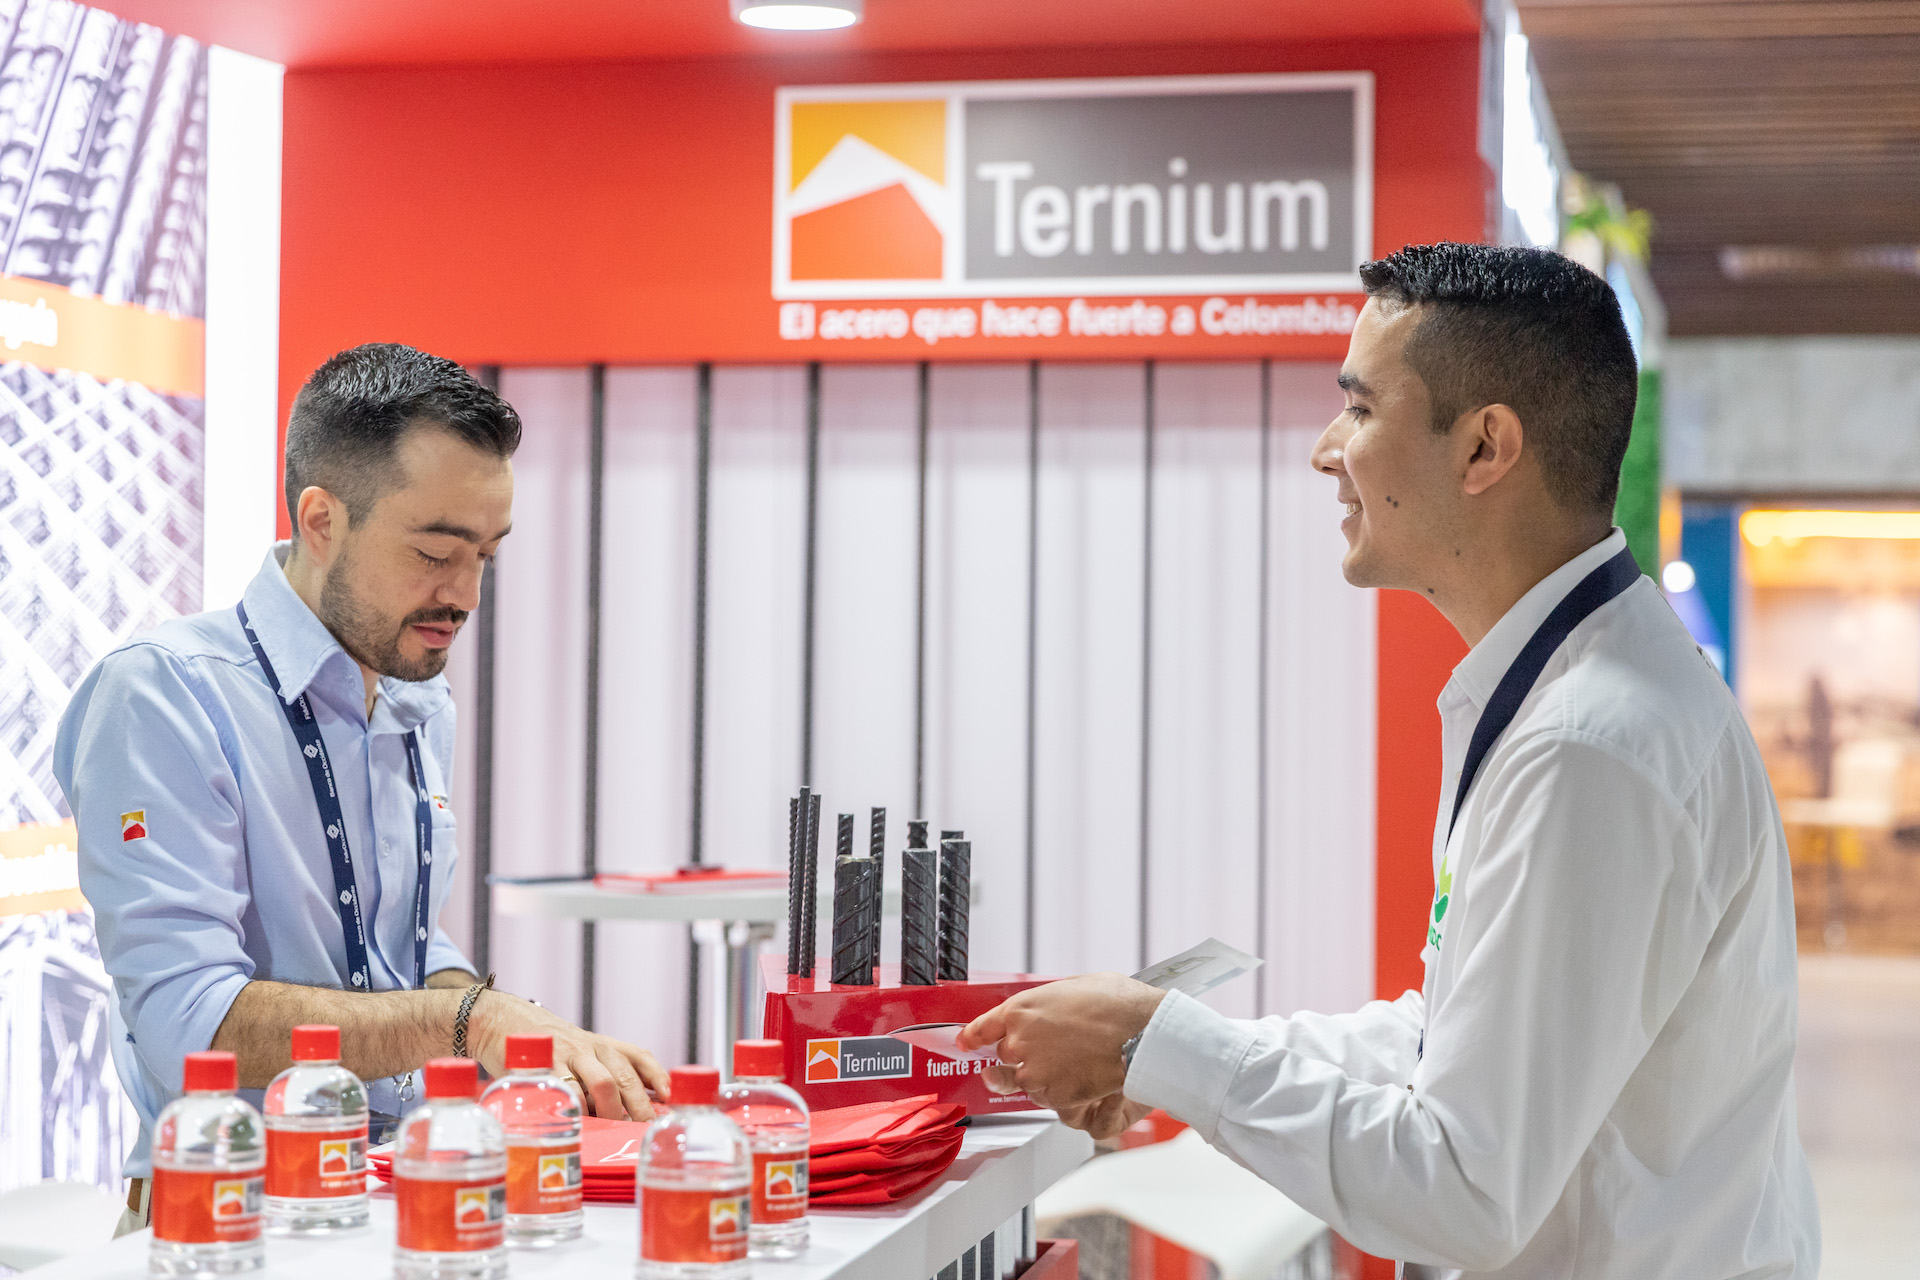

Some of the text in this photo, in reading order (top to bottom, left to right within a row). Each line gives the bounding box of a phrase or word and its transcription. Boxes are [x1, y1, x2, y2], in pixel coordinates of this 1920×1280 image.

[976, 157, 1329, 257] Ternium
[779, 297, 1357, 345] El acero que hace fuerte a Colombia
[327, 778, 336, 798] Banco
[843, 1052, 905, 1073] Ternium
[926, 1058, 969, 1077] fuerte
[973, 1060, 982, 1074] a
